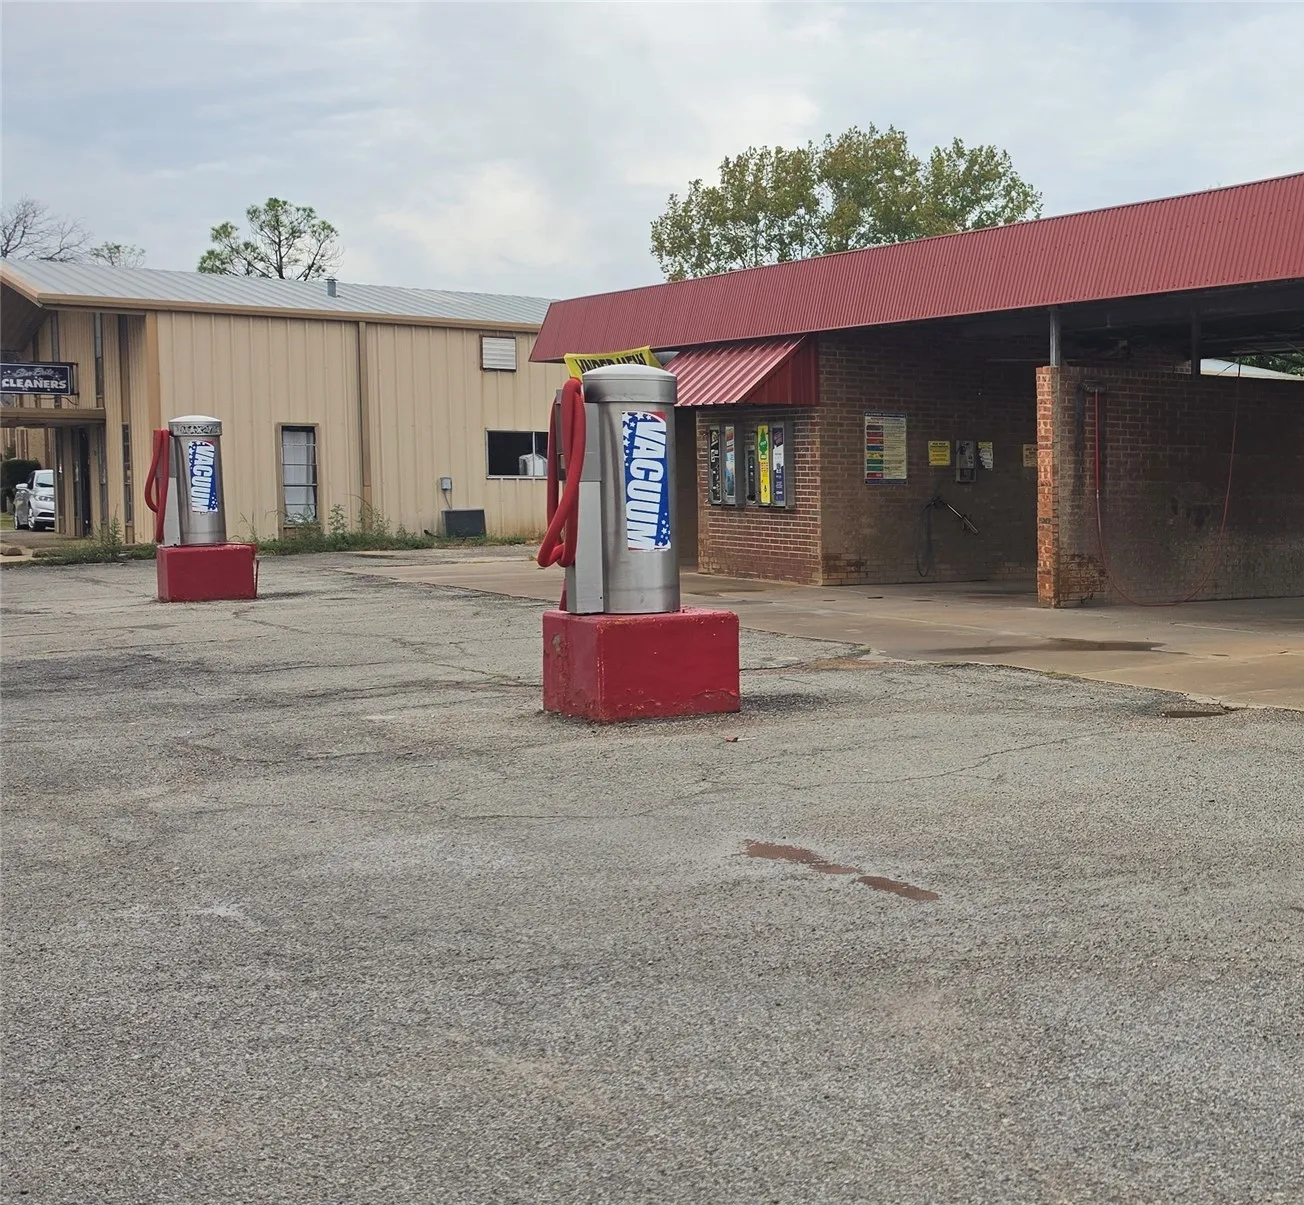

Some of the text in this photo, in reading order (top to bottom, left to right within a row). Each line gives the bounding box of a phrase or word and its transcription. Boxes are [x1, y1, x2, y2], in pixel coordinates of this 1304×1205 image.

[2, 378, 67, 389] CLEANERS
[191, 444, 214, 512] VACUUM
[626, 421, 667, 550] VACUUM
